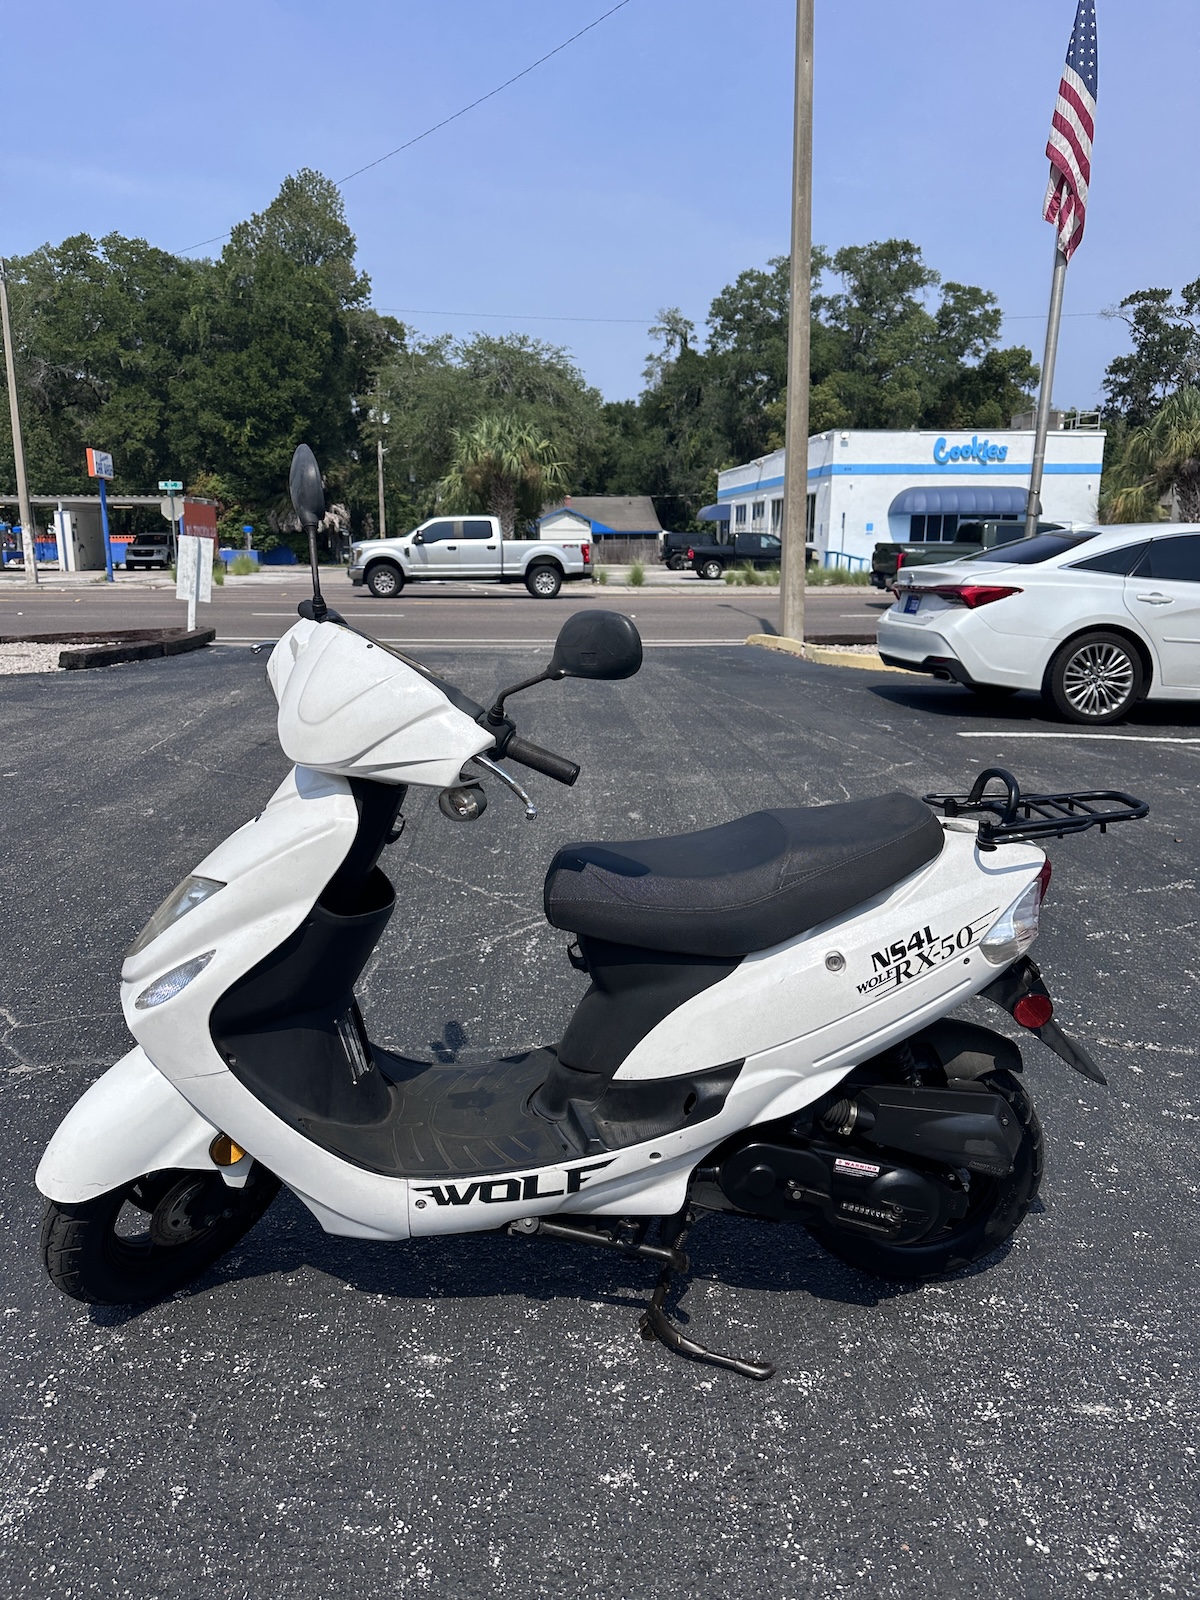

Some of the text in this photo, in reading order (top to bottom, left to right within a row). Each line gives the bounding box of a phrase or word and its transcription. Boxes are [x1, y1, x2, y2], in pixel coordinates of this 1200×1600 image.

[933, 435, 1008, 464] Cookies
[856, 926, 973, 994] WOLF RX-50
[871, 925, 940, 972] NS4L
[412, 1156, 620, 1206] WOLF
[844, 1161, 877, 1171] WARNING
